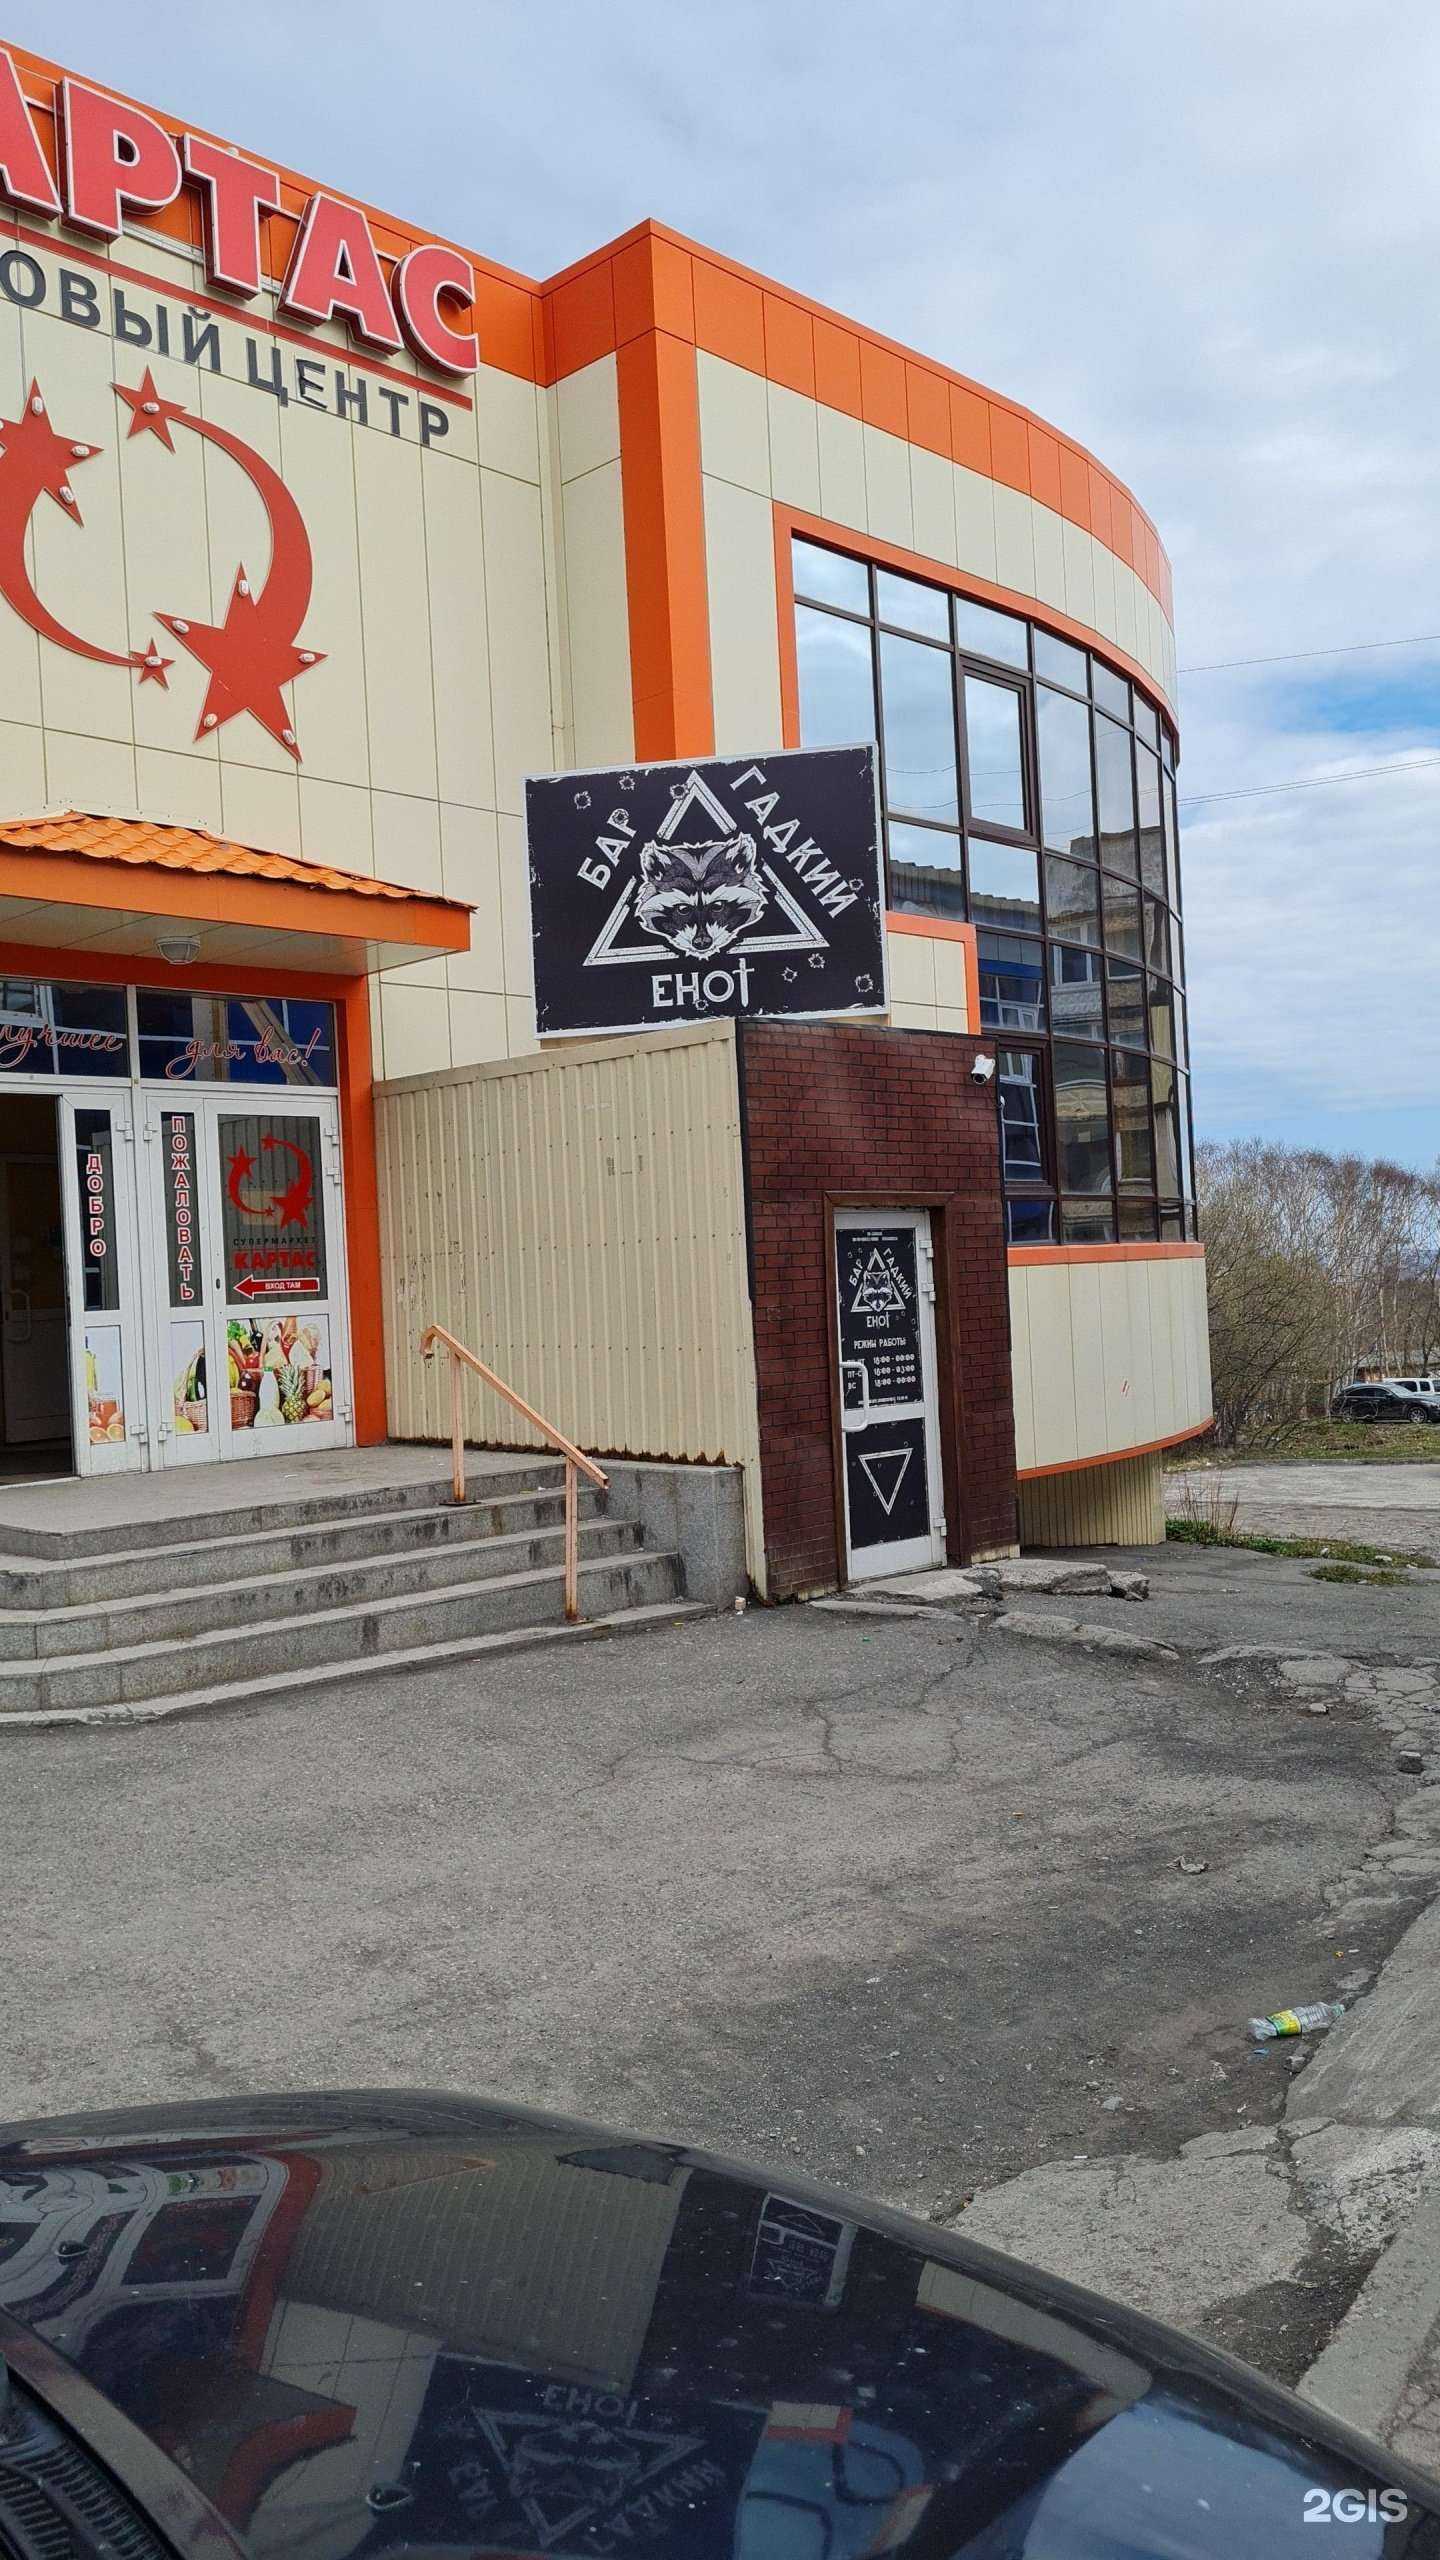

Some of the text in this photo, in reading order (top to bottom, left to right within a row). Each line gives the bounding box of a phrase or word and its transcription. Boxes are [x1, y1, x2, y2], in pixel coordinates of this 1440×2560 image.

[0, 249, 450, 448] ОВЫЙ ЦЕНТР
[576, 807, 641, 891] БАР
[729, 765, 864, 919] ГАДКИЙ
[651, 957, 755, 1008] ЕНОТ
[86, 1153, 107, 1257] ДОБРО
[171, 1116, 195, 1301] ПОЖАЛОВАТЬ
[233, 1248, 317, 1271] КАРТАС
[849, 1259, 863, 1287] БАР
[883, 1248, 913, 1299] ГАДКИЙ
[264, 1281, 301, 1291] ВХОД ТАМ
[879, 1337, 907, 1348] РАБОТЫ
